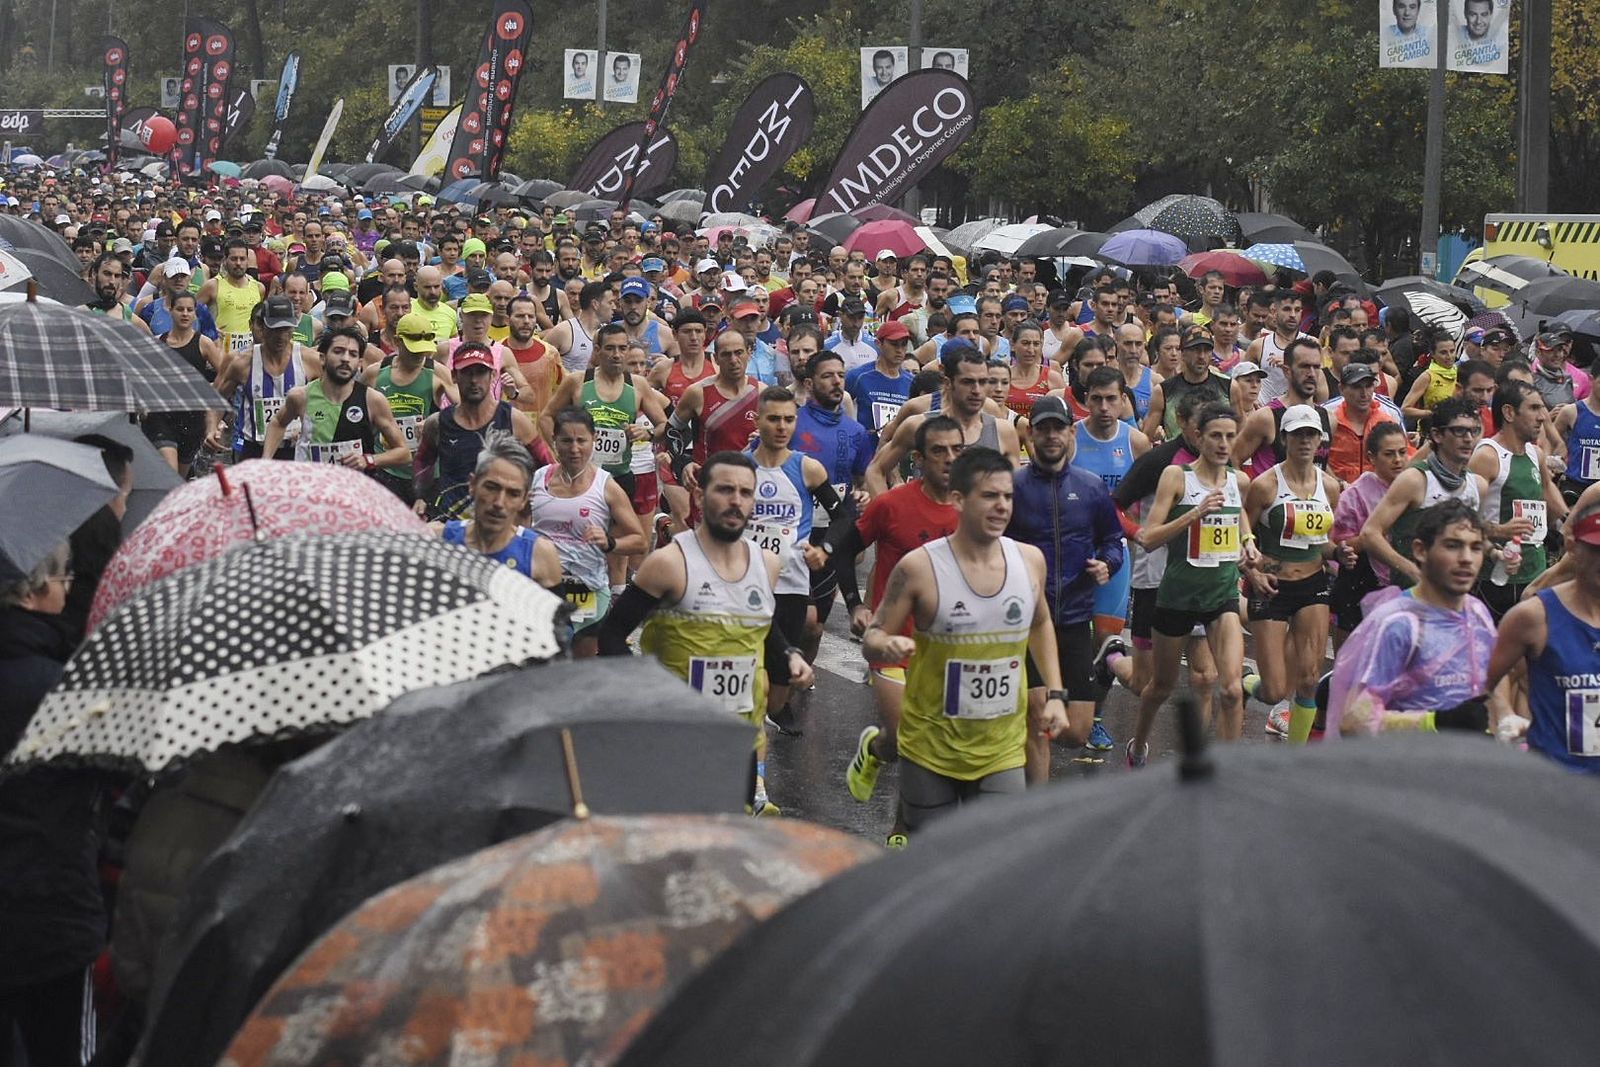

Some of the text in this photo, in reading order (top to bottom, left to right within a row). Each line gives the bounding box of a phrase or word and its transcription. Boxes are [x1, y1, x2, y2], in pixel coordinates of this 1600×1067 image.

[1397, 47, 1430, 63] CAMBIO
[1466, 52, 1501, 66] CAMBIO
[1, 112, 29, 133] edp
[711, 84, 804, 214] IMDEC
[828, 87, 966, 214] IMDECO
[876, 114, 973, 200] Municipal de Deportes Córdoba
[595, 438, 620, 453] 309
[751, 504, 796, 517] BRIJA
[1306, 513, 1323, 530] 82
[1213, 528, 1229, 545] 81
[970, 675, 1009, 699] 305
